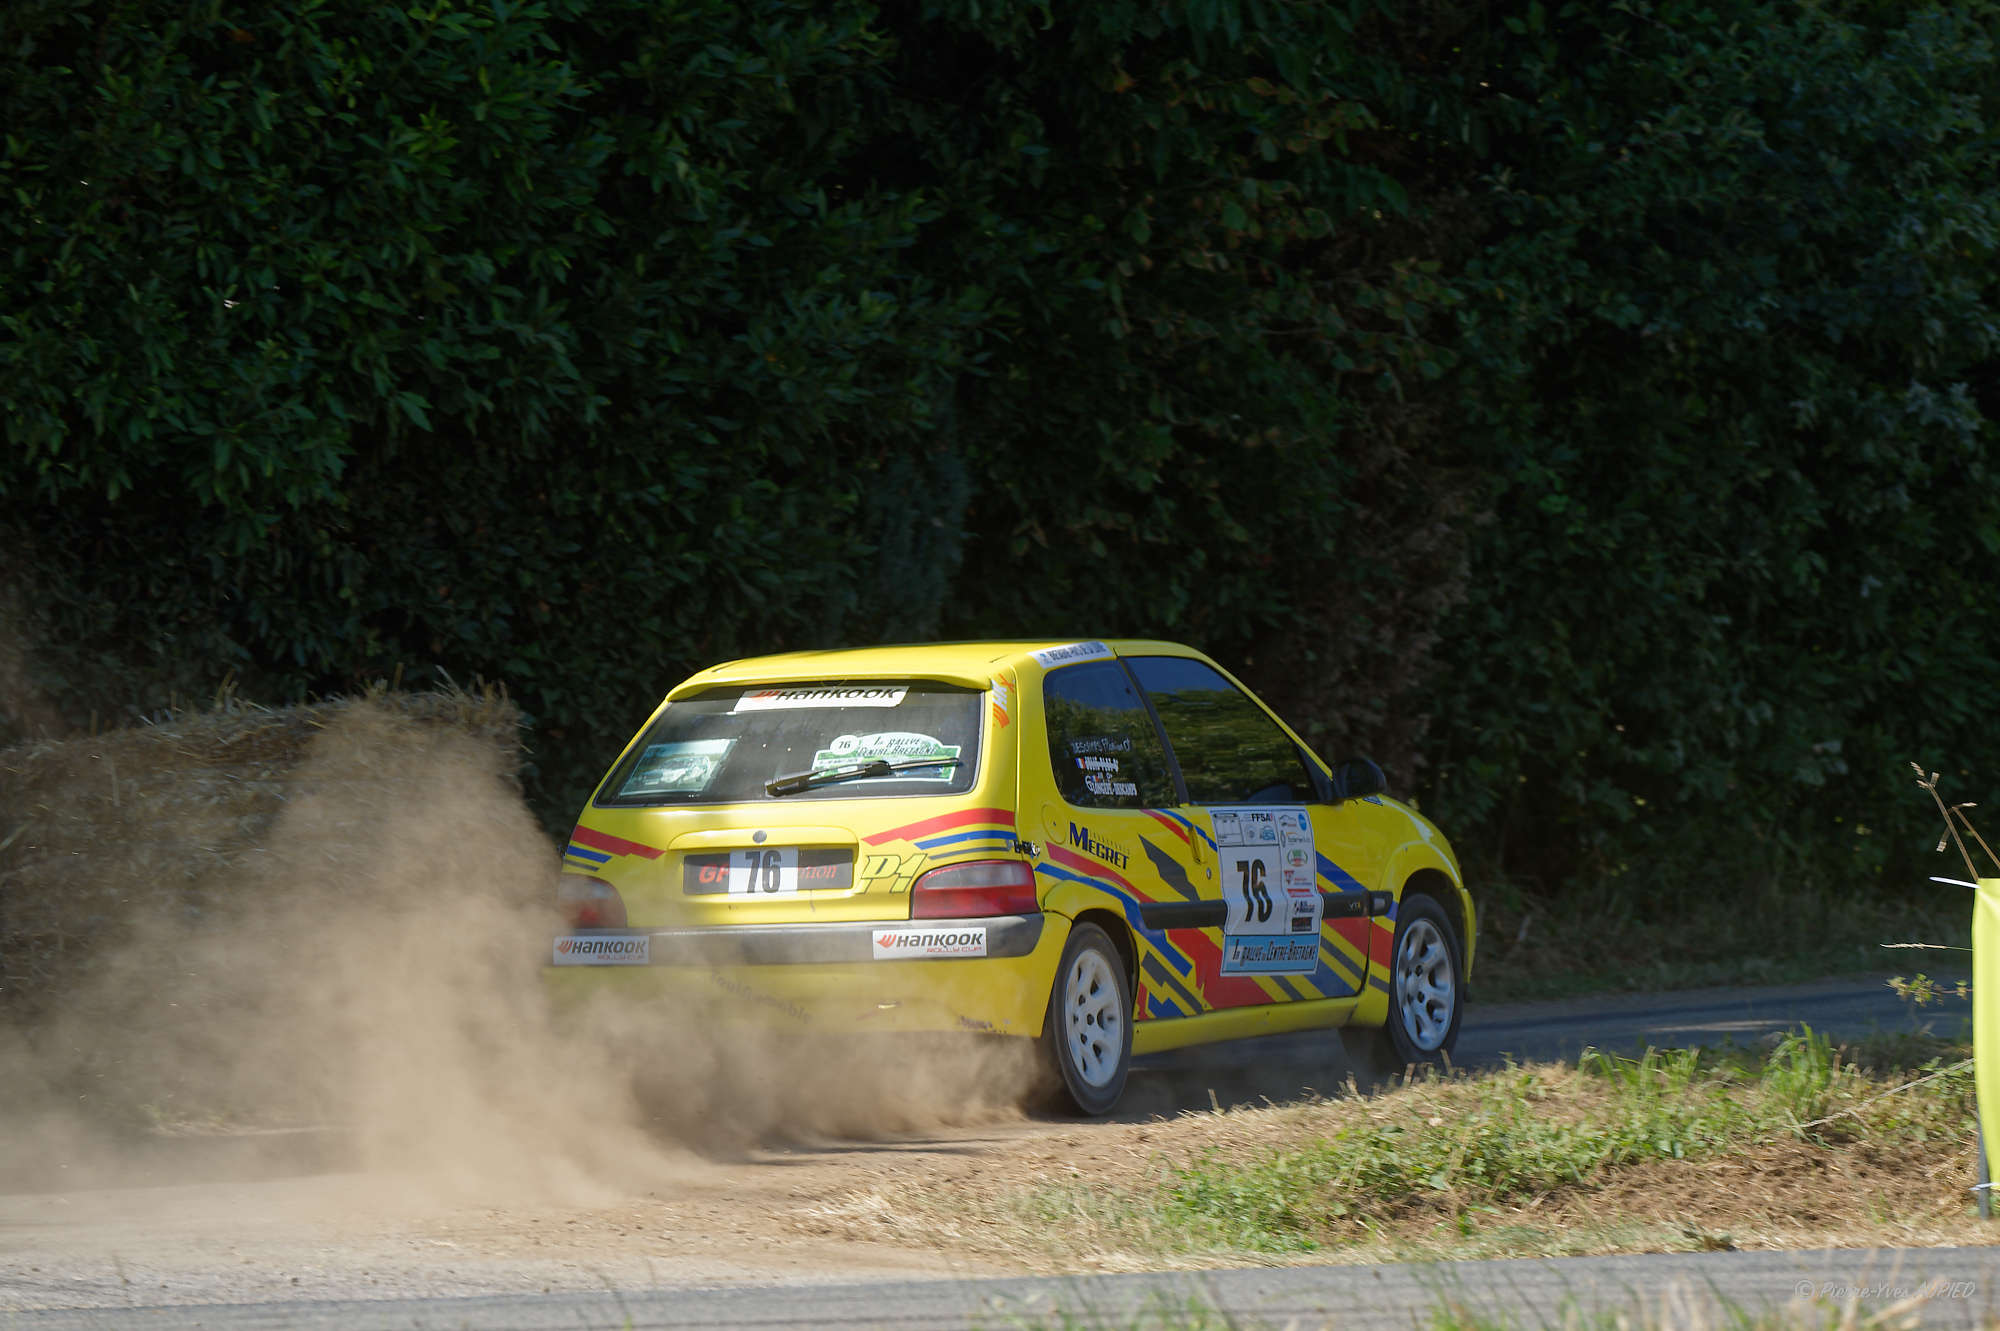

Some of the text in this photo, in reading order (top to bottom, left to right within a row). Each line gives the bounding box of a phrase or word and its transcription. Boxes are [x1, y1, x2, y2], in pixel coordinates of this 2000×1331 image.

[838, 741, 851, 749] 76
[887, 738, 921, 748] RALLYE
[891, 744, 938, 755] BRETAGNE
[1251, 813, 1272, 822] FFSA
[745, 850, 782, 893] 76
[855, 853, 928, 894] P1
[1236, 859, 1273, 922] 76
